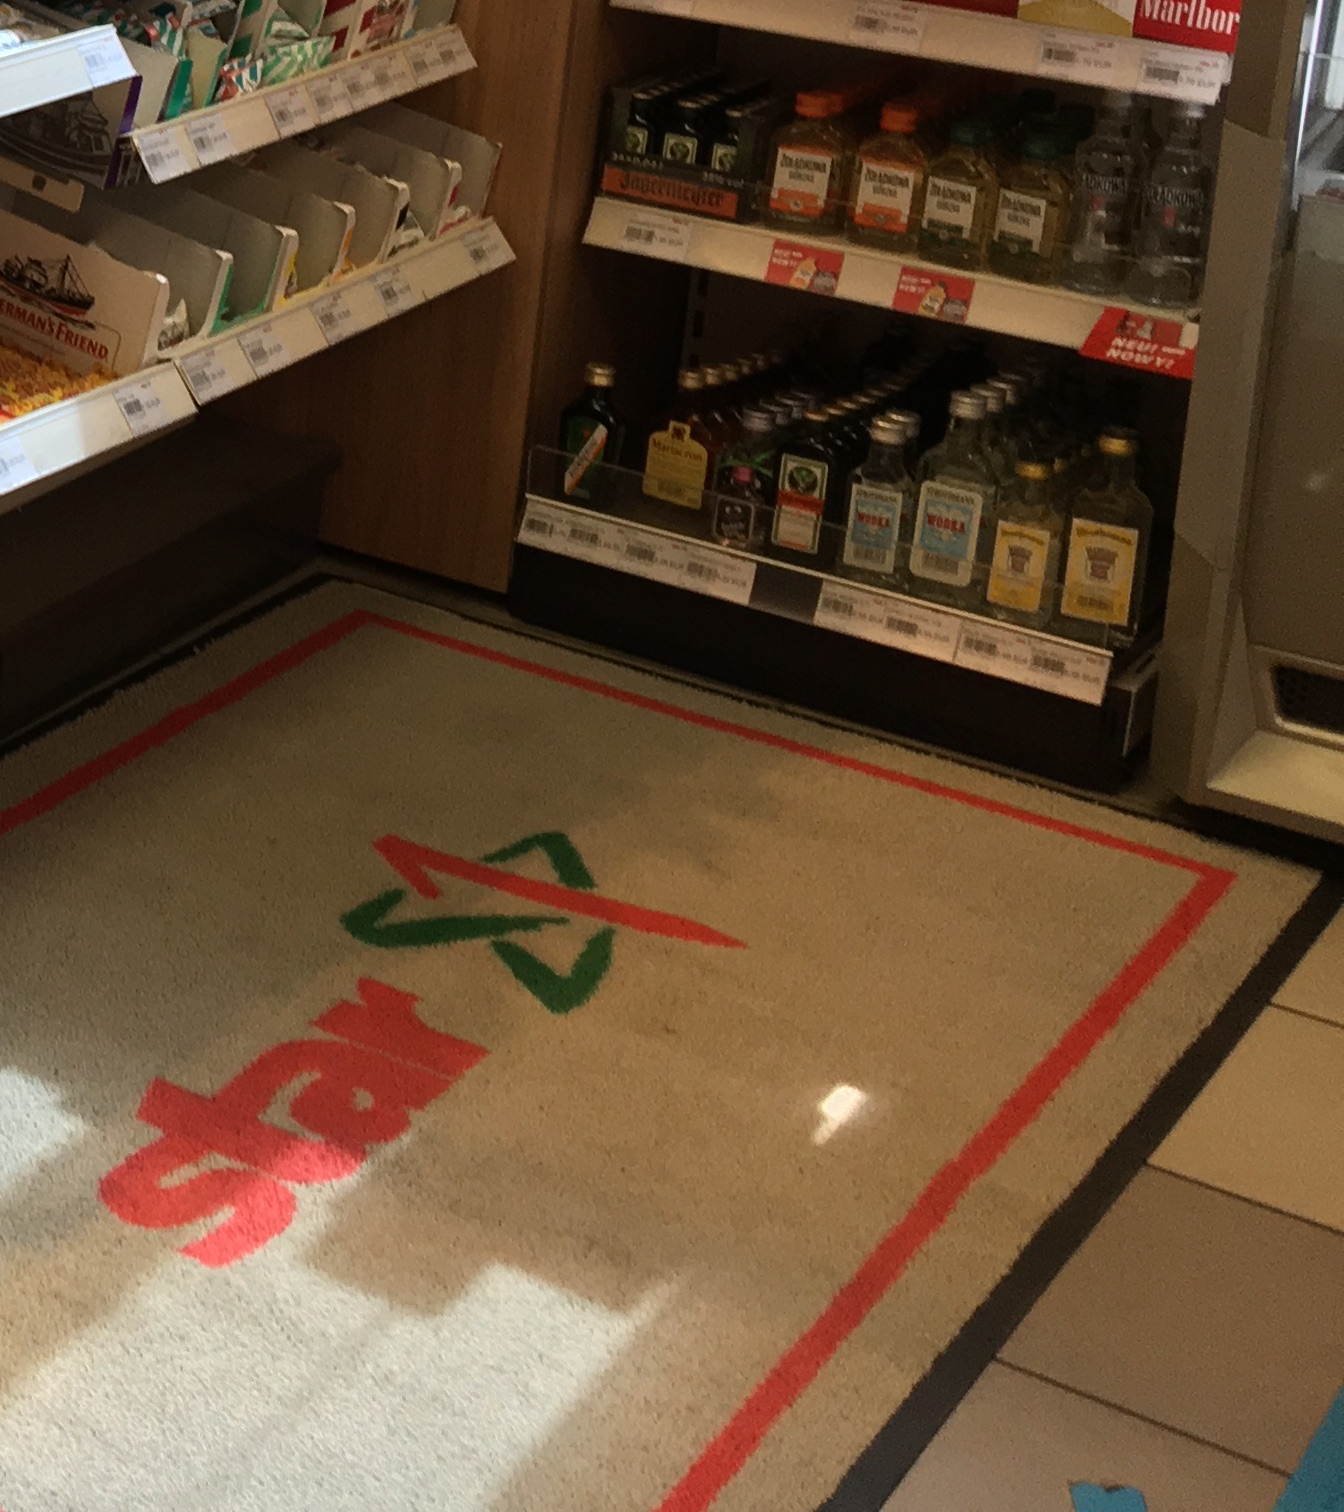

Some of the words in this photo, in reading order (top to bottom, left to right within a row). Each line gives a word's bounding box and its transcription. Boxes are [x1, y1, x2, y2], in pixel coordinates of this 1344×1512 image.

[618, 172, 724, 208] Jägermeister
[55, 314, 110, 362] FRIEND
[1112, 336, 1160, 356] NEU!
[857, 512, 890, 530] WODKA
[926, 511, 966, 536] WODKA
[97, 974, 492, 1270] star
